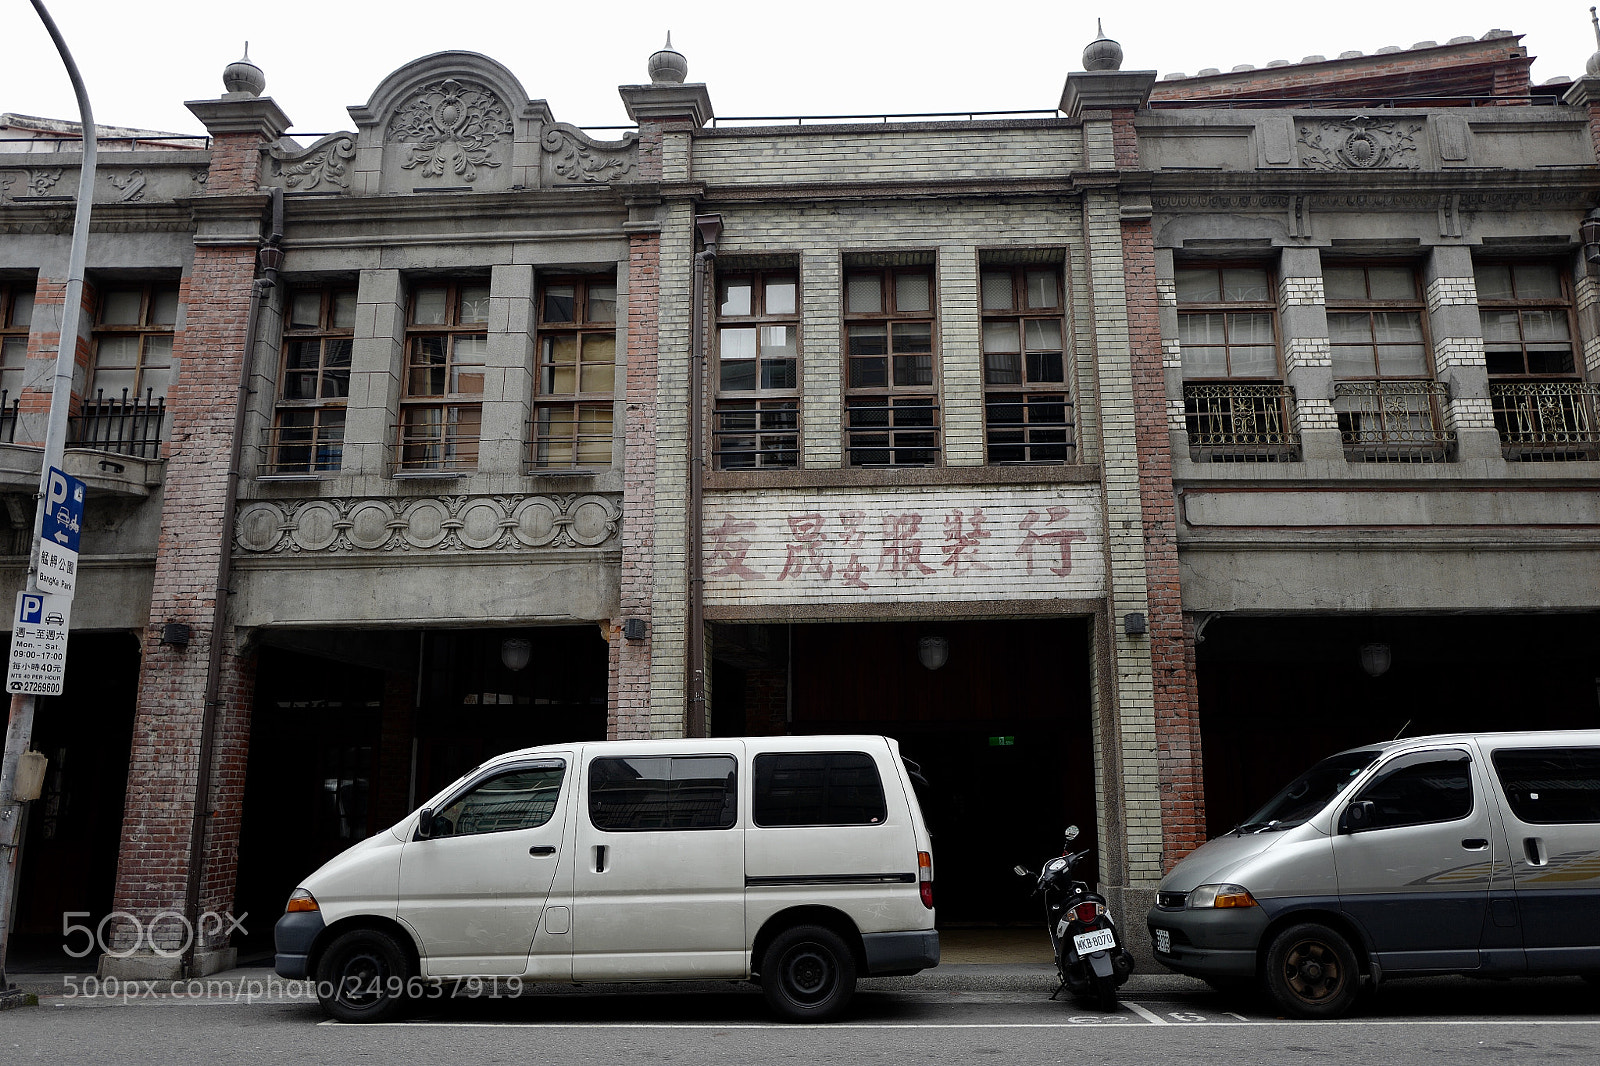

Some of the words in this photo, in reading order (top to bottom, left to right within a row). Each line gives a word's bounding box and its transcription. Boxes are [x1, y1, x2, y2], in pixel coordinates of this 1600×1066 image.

[46, 470, 68, 516] P
[61, 579, 72, 591] Park
[22, 596, 40, 621] P
[16, 626, 65, 641] 週一至週六
[13, 662, 62, 673] 每小時40元
[24, 682, 60, 693] 27269600
